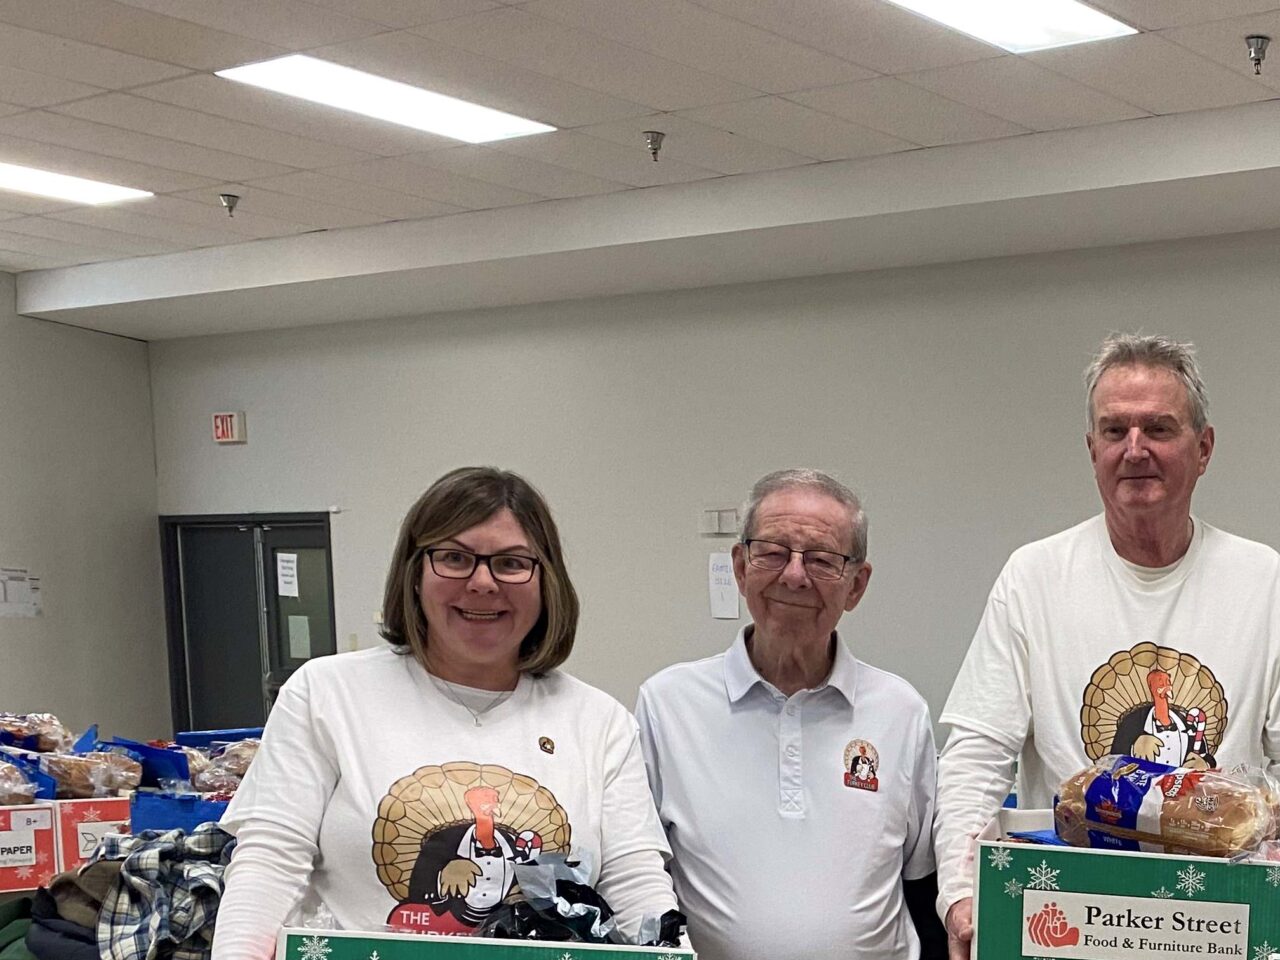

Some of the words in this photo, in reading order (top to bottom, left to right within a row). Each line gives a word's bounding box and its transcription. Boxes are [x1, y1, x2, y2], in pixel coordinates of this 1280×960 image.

[214, 414, 234, 440] EXIT
[0, 845, 32, 856] PAPER
[400, 910, 430, 926] THE
[1084, 905, 1165, 930] Parker
[1172, 911, 1242, 935] Street
[1083, 934, 1118, 948] Food
[1122, 937, 1135, 949] &
[1138, 938, 1203, 953] Furniture
[1207, 942, 1243, 956] Bank
